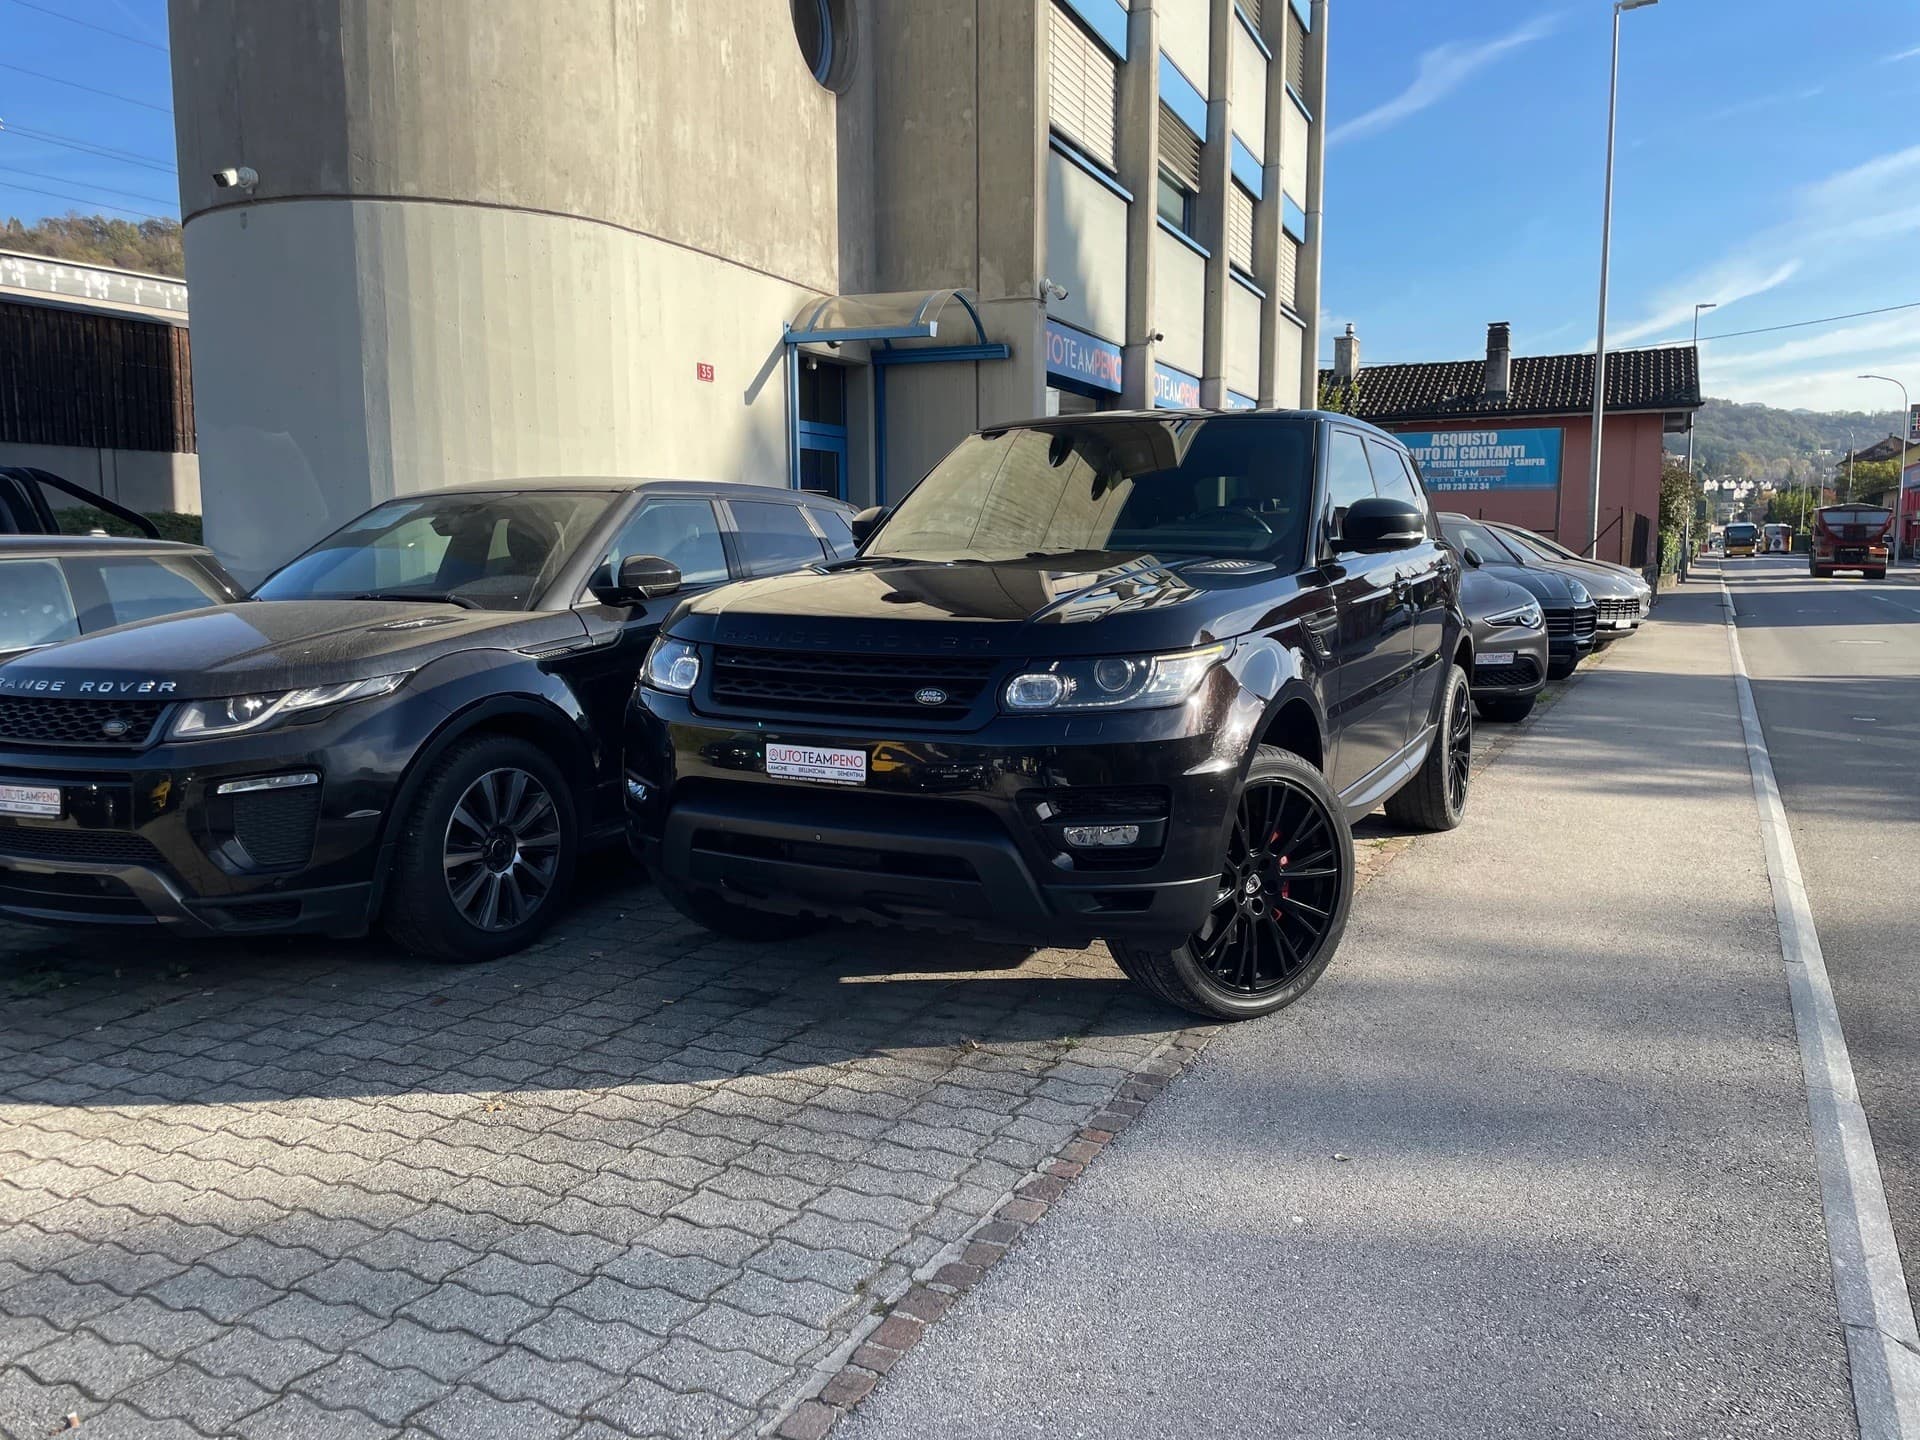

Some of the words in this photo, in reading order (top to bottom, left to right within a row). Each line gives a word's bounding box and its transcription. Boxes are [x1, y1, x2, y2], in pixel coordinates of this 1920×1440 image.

[701, 365, 712, 379] 35
[1431, 432, 1498, 447] ACQUISTO
[1443, 447, 1457, 460] IN
[1460, 445, 1526, 459] CONTANTI
[1431, 459, 1458, 468] VEICOLI
[1459, 459, 1509, 467] COMMERCIALI
[1515, 458, 1545, 466] CAMPER
[1453, 469, 1479, 477] TEAM
[80, 681, 177, 692] ROVER
